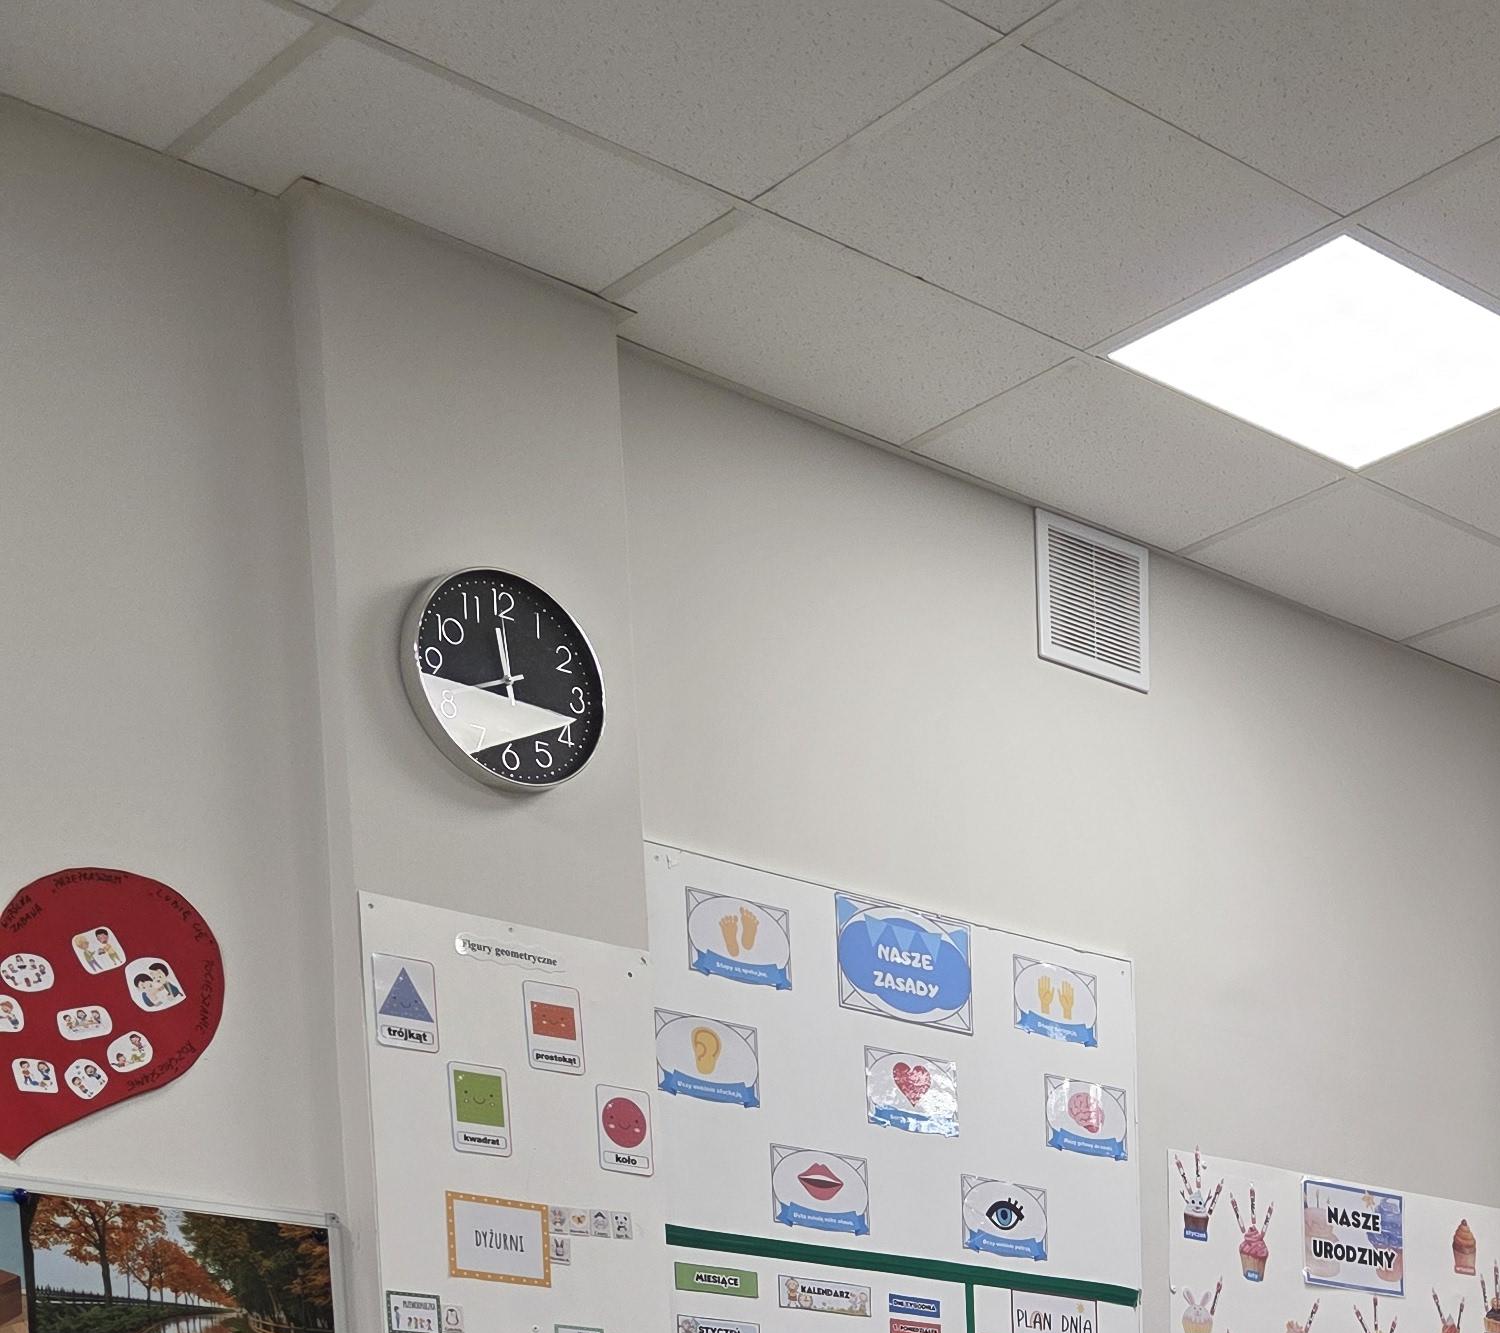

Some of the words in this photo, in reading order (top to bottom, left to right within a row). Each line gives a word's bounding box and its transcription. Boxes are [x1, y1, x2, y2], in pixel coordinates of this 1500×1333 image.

[462, 592, 480, 623] 11
[491, 588, 515, 621] 12
[436, 613, 465, 645] 10
[533, 612, 540, 639] 1
[425, 646, 443, 674] 9
[555, 645, 572, 673] 2
[440, 690, 458, 719] 8
[569, 686, 585, 714] 3
[470, 724, 486, 751] 7
[557, 724, 575, 747] 4
[501, 743, 520, 771] 6
[535, 741, 553, 768] 5
[462, 938, 493, 959] Figury
[495, 944, 558, 967] geometryczne
[877, 943, 934, 971] NASZE
[873, 970, 939, 998] ZASADY
[387, 1026, 428, 1043] trójkąt
[535, 1051, 577, 1066] prostokąt
[463, 1133, 500, 1147] kwadrat
[615, 1153, 638, 1166] koło
[1328, 1205, 1380, 1232] NASZE
[474, 1228, 525, 1253] DYŻURNI
[1313, 1239, 1395, 1269] URODZINY
[695, 1272, 739, 1288] MIESIĄCE
[800, 1285, 850, 1299] KALENDARZ
[1017, 1308, 1052, 1331] PLAN
